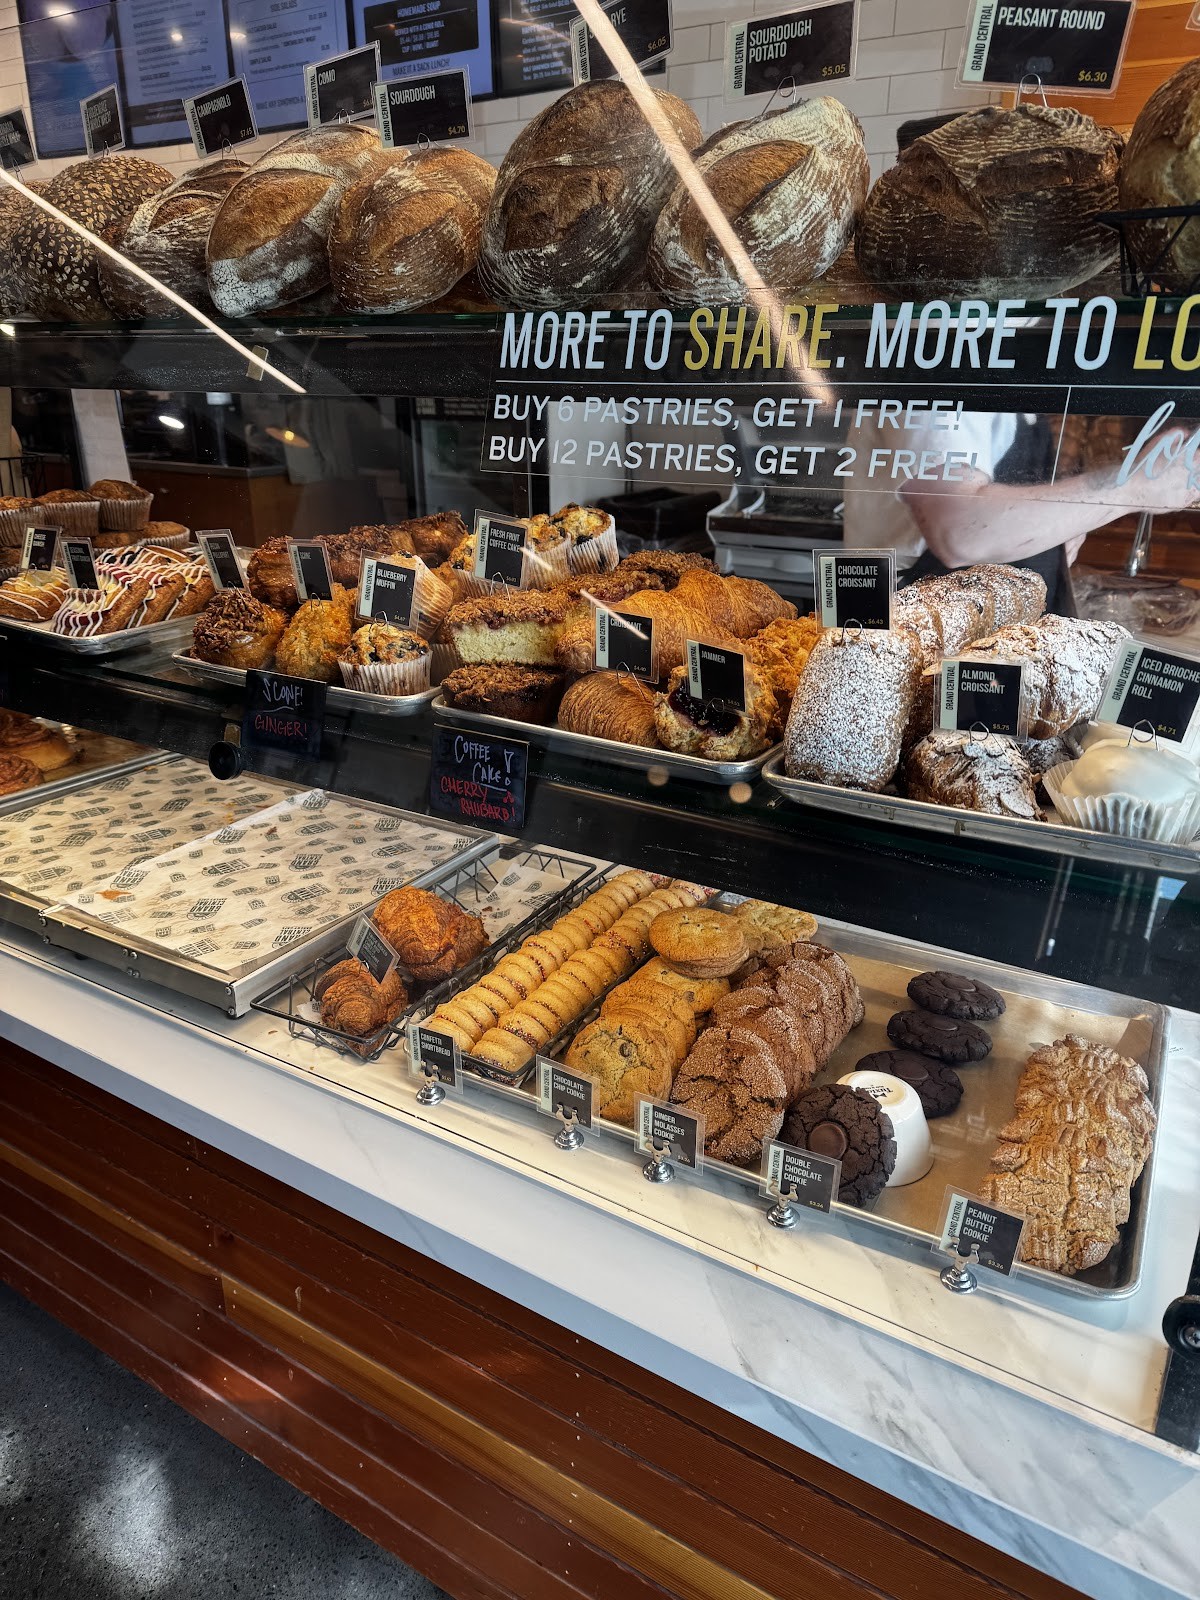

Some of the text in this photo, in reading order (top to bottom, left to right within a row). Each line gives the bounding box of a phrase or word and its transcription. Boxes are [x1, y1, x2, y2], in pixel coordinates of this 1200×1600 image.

[998, 6, 1106, 31] PEASANT ROUND
[578, 27, 587, 57] CENTRAL
[750, 19, 812, 47] SOURDOUGH
[971, 3, 994, 71] GRAND CENTRAL
[647, 37, 667, 51] $6.05
[749, 41, 787, 64] POTATO
[734, 31, 745, 90] GRAND CENTRAL
[318, 69, 336, 86] COMO
[822, 64, 846, 77] $5.05
[1078, 70, 1107, 83] $6.30
[390, 85, 436, 106] SOURDOUGH
[197, 94, 231, 118] CAMPAGNOLO
[190, 107, 199, 131] CENTRAL
[379, 92, 392, 140] GRAND CENTRAL
[447, 125, 466, 136] $4.70
[500, 310, 611, 369] MORE
[624, 309, 673, 370] TO
[684, 304, 844, 370] SHARE.
[865, 299, 1026, 369] MORE
[1045, 296, 1118, 371] TO
[494, 395, 550, 421] BUY
[558, 396, 575, 421] 6
[583, 396, 740, 431] PASTRIES,
[752, 398, 824, 428] GET
[833, 398, 844, 428] 1
[855, 399, 964, 431] FREE!
[488, 436, 978, 482] BUY 12 PASTRIES, GET 2 FREE!
[490, 528, 506, 540] FRESH
[489, 538, 520, 553] COFFEE CAKE
[366, 564, 374, 585] CENTRAL
[377, 568, 408, 583] BLUEBERRY
[825, 562, 833, 588] CENTRAL
[838, 565, 878, 576] CHOCOLATE
[375, 580, 396, 590] MUFFIN
[838, 577, 877, 588] CROISSANT
[690, 646, 698, 666] CENTRAL
[701, 650, 726, 664] JAMMER
[961, 669, 995, 681] ALMOND
[1112, 651, 1138, 701] GRAND CENTRAL
[1141, 657, 1200, 683] ICED BRIOCHE
[945, 665, 956, 711] GRAND CENTRAL
[961, 681, 1005, 695] CROISSANT
[1136, 671, 1185, 693] CINNAMON
[1131, 684, 1153, 700] ROLL
[254, 715, 308, 737] GINGER!
[992, 723, 1010, 731] $5.75
[440, 776, 488, 803] CHERRY
[420, 1033, 442, 1046] CONFETTI
[421, 1041, 451, 1057] SHORTBREAD
[553, 1074, 584, 1092] CHOCOLATE
[553, 1082, 586, 1101] CHIP COOKIE
[654, 1110, 676, 1124] GINGER
[654, 1119, 685, 1136] MOLASSES
[654, 1128, 675, 1142] COOKIE
[773, 1149, 781, 1168] CENTRAL
[785, 1155, 811, 1170] DOUBLE
[783, 1172, 808, 1186] COOKIE
[784, 1164, 822, 1182] CHOCOLATE
[809, 1200, 824, 1209] $3.26
[948, 1201, 964, 1237] GRAND CENTRAL
[968, 1207, 997, 1224] PEANUT
[962, 1227, 990, 1243] COOKIE
[965, 1217, 994, 1235] BUTTER
[988, 1259, 1004, 1270] $3.26
